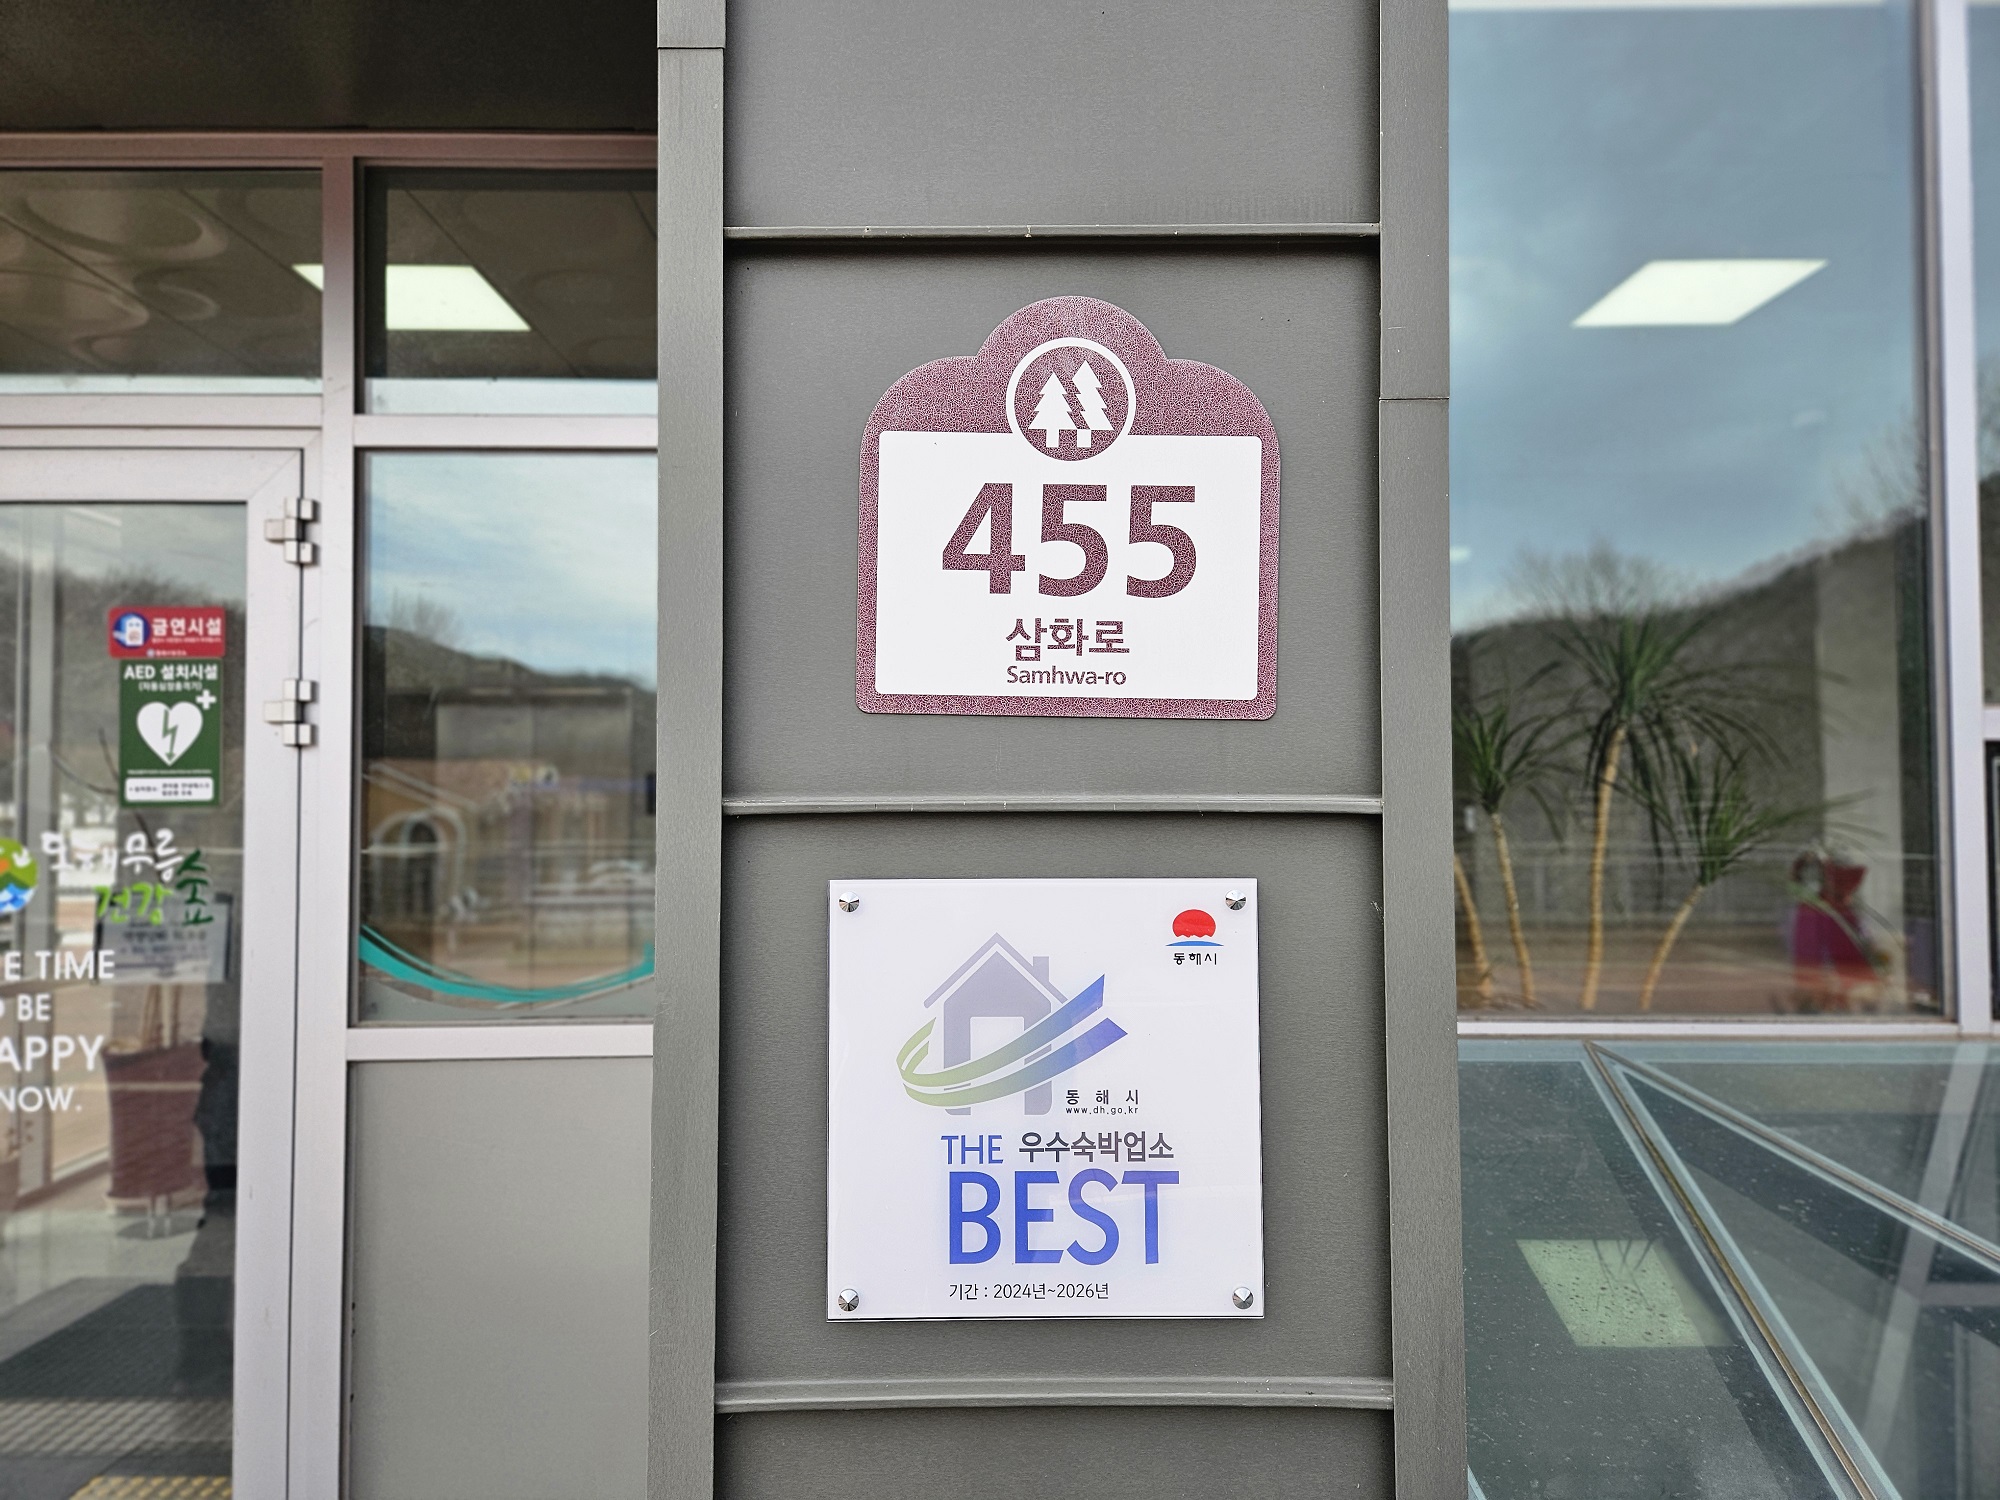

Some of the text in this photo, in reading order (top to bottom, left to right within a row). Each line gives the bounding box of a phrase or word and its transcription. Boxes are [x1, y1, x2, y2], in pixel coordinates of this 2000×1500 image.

[941, 482, 1197, 599] 455
[152, 618, 221, 635] 금연시설
[1006, 617, 1130, 662] 삼화로
[124, 664, 218, 680] AED 설치시설
[1007, 665, 1127, 686] Samhwa-ro
[35, 950, 115, 980] TIME
[1172, 952, 1217, 966] 동해시
[17, 993, 51, 1021] BE
[1065, 1105, 1139, 1116] www.dh.go.kr
[941, 1134, 1004, 1165] THE
[1018, 1130, 1175, 1163] 우수숙박업소
[948, 1168, 1180, 1266] BEST
[949, 1283, 979, 1300] 기간
[993, 1282, 1109, 1300] 2024년~2026년
